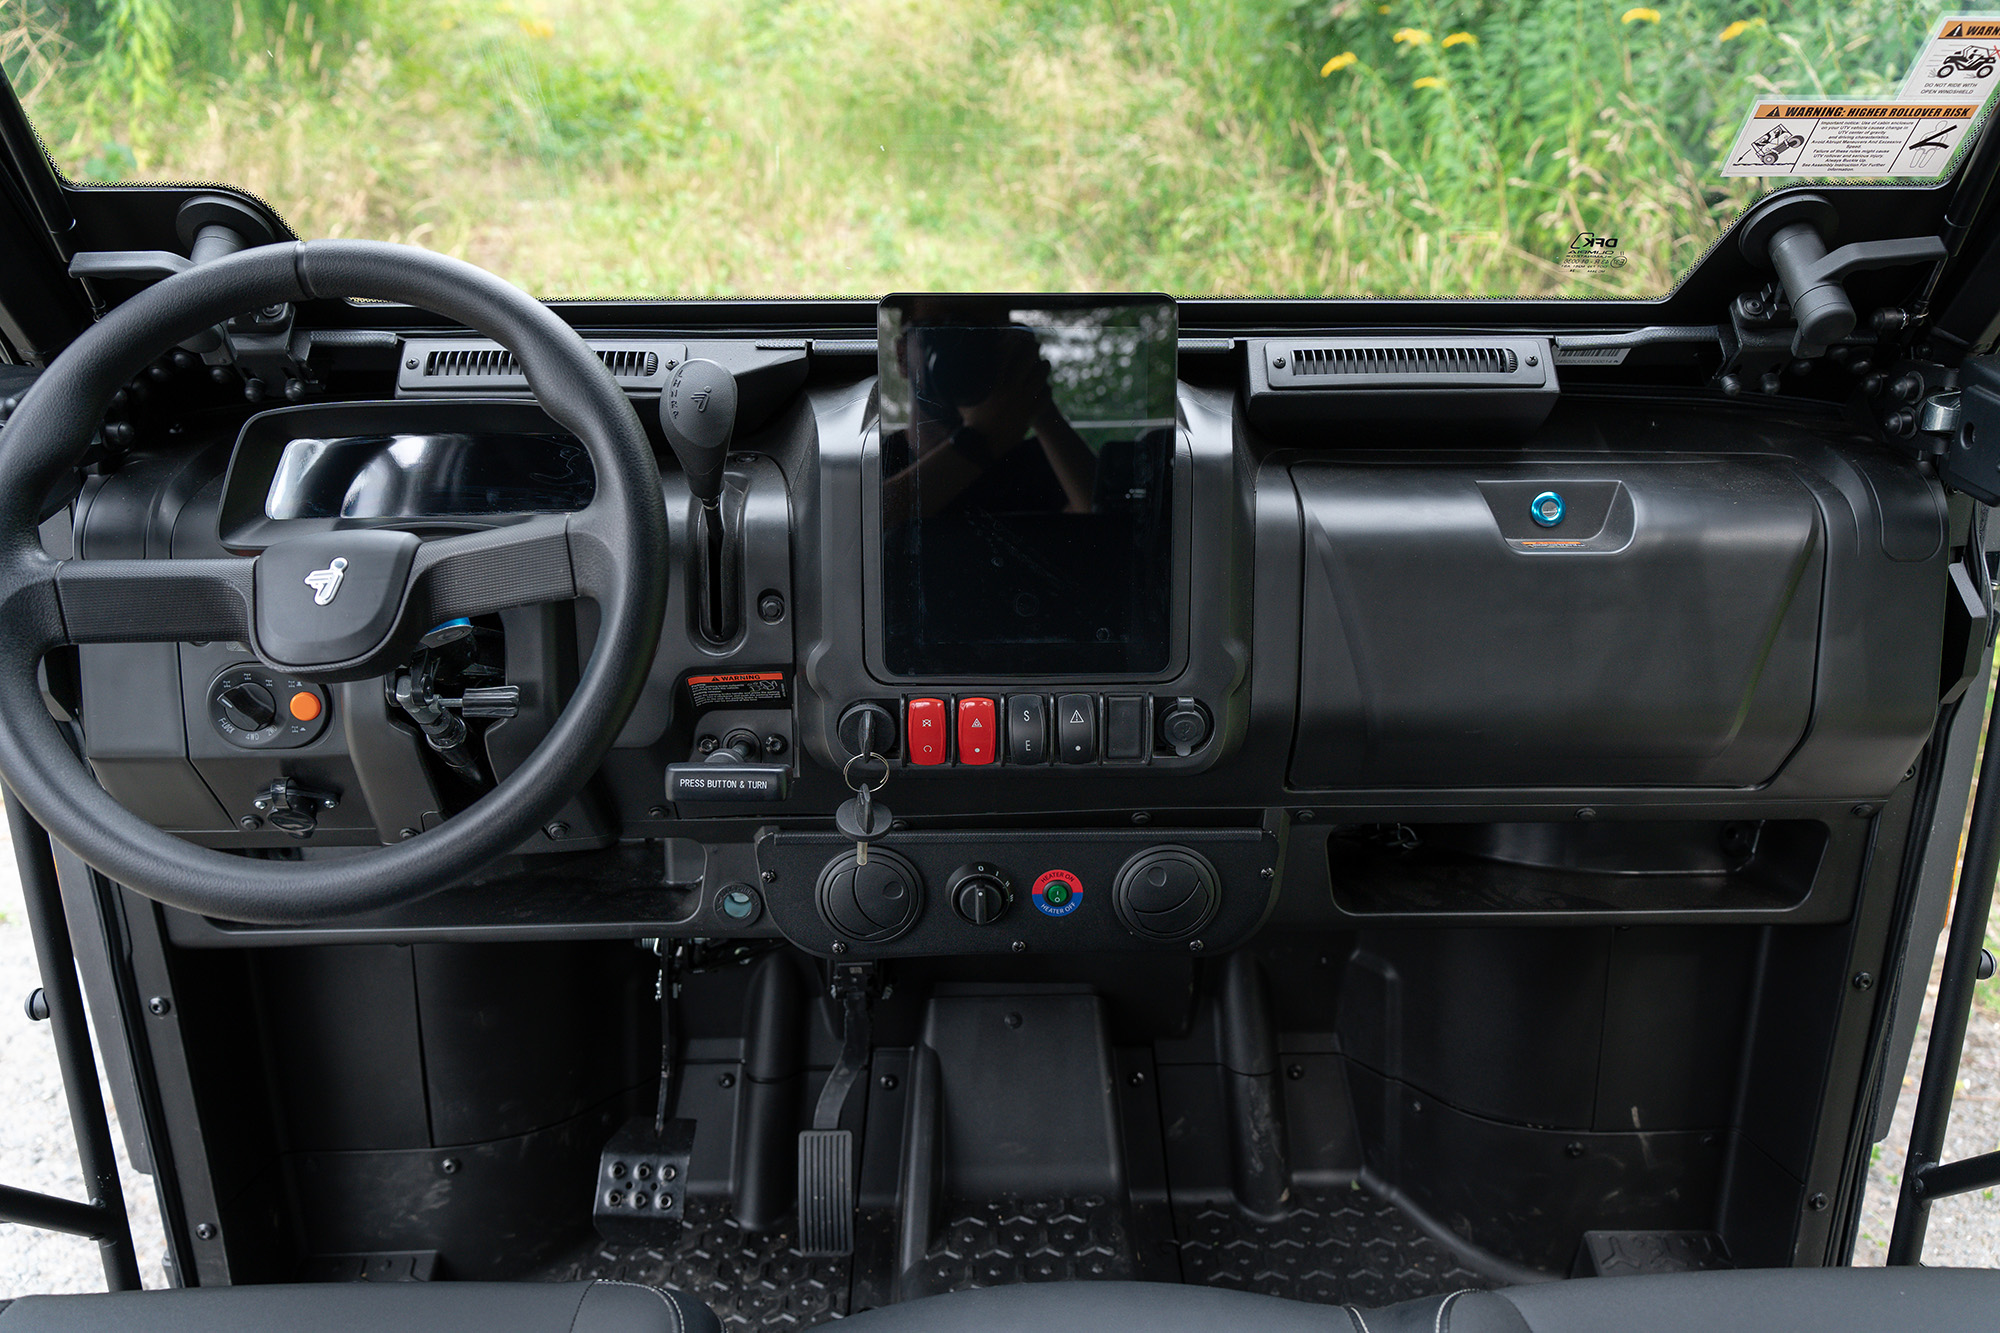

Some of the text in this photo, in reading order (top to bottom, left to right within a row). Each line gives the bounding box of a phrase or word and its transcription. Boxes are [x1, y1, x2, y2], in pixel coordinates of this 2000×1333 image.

[1785, 107, 1970, 117] WARNING: HIGHER ROLLOVER RISK
[1023, 710, 1030, 722] S
[1025, 740, 1031, 751] E
[680, 779, 768, 789] PRESS BUTTON & TURN
[1041, 872, 1075, 883] HEATER ON
[1041, 902, 1076, 914] HEATER OFF
